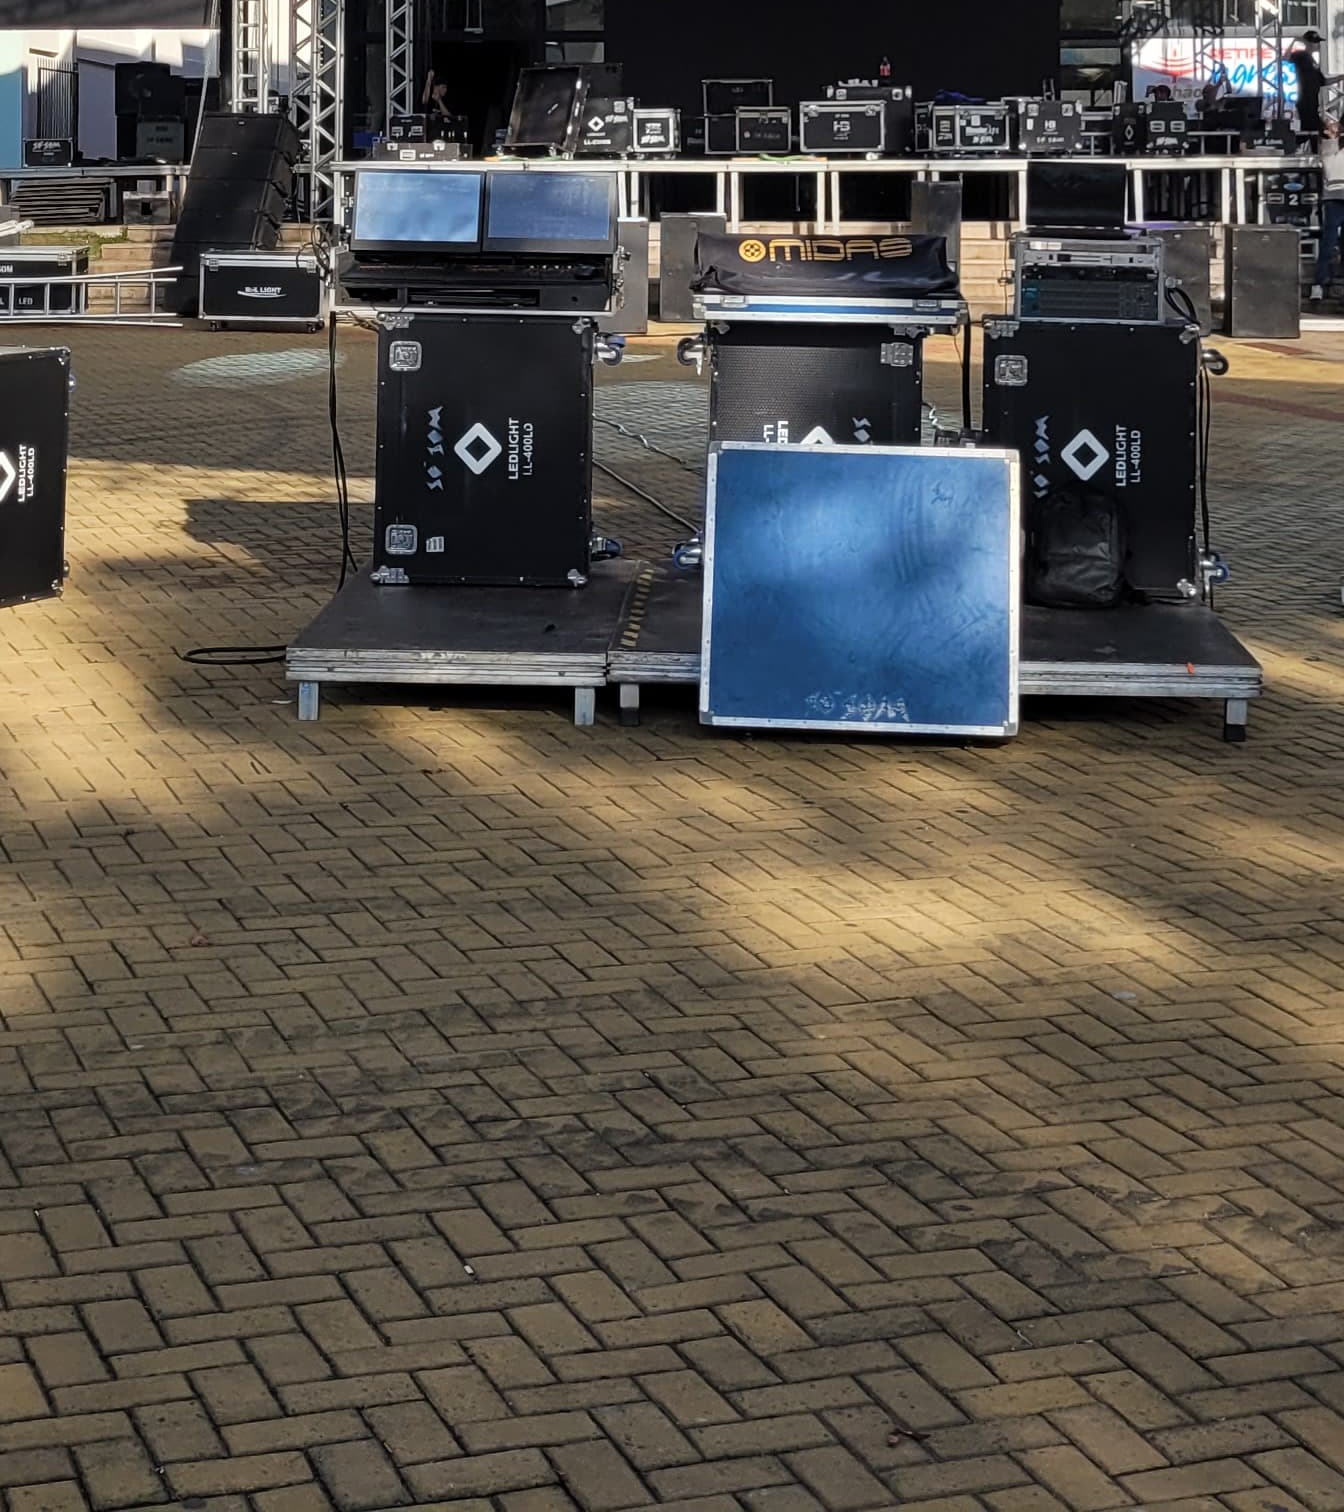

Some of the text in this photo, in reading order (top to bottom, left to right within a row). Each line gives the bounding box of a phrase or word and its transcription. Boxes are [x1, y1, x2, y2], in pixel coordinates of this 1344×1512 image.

[1288, 193, 1299, 206] 2
[768, 237, 913, 262] MIDAS
[18, 296, 33, 305] LED
[17, 444, 27, 502] LEDLIGHT
[26, 447, 35, 496] LL-400LD
[508, 416, 520, 480] LEDLIGHT
[522, 422, 534, 476] LL-400LD
[1115, 424, 1128, 487] LEDLIGHT
[1130, 429, 1142, 483] LL-400LD
